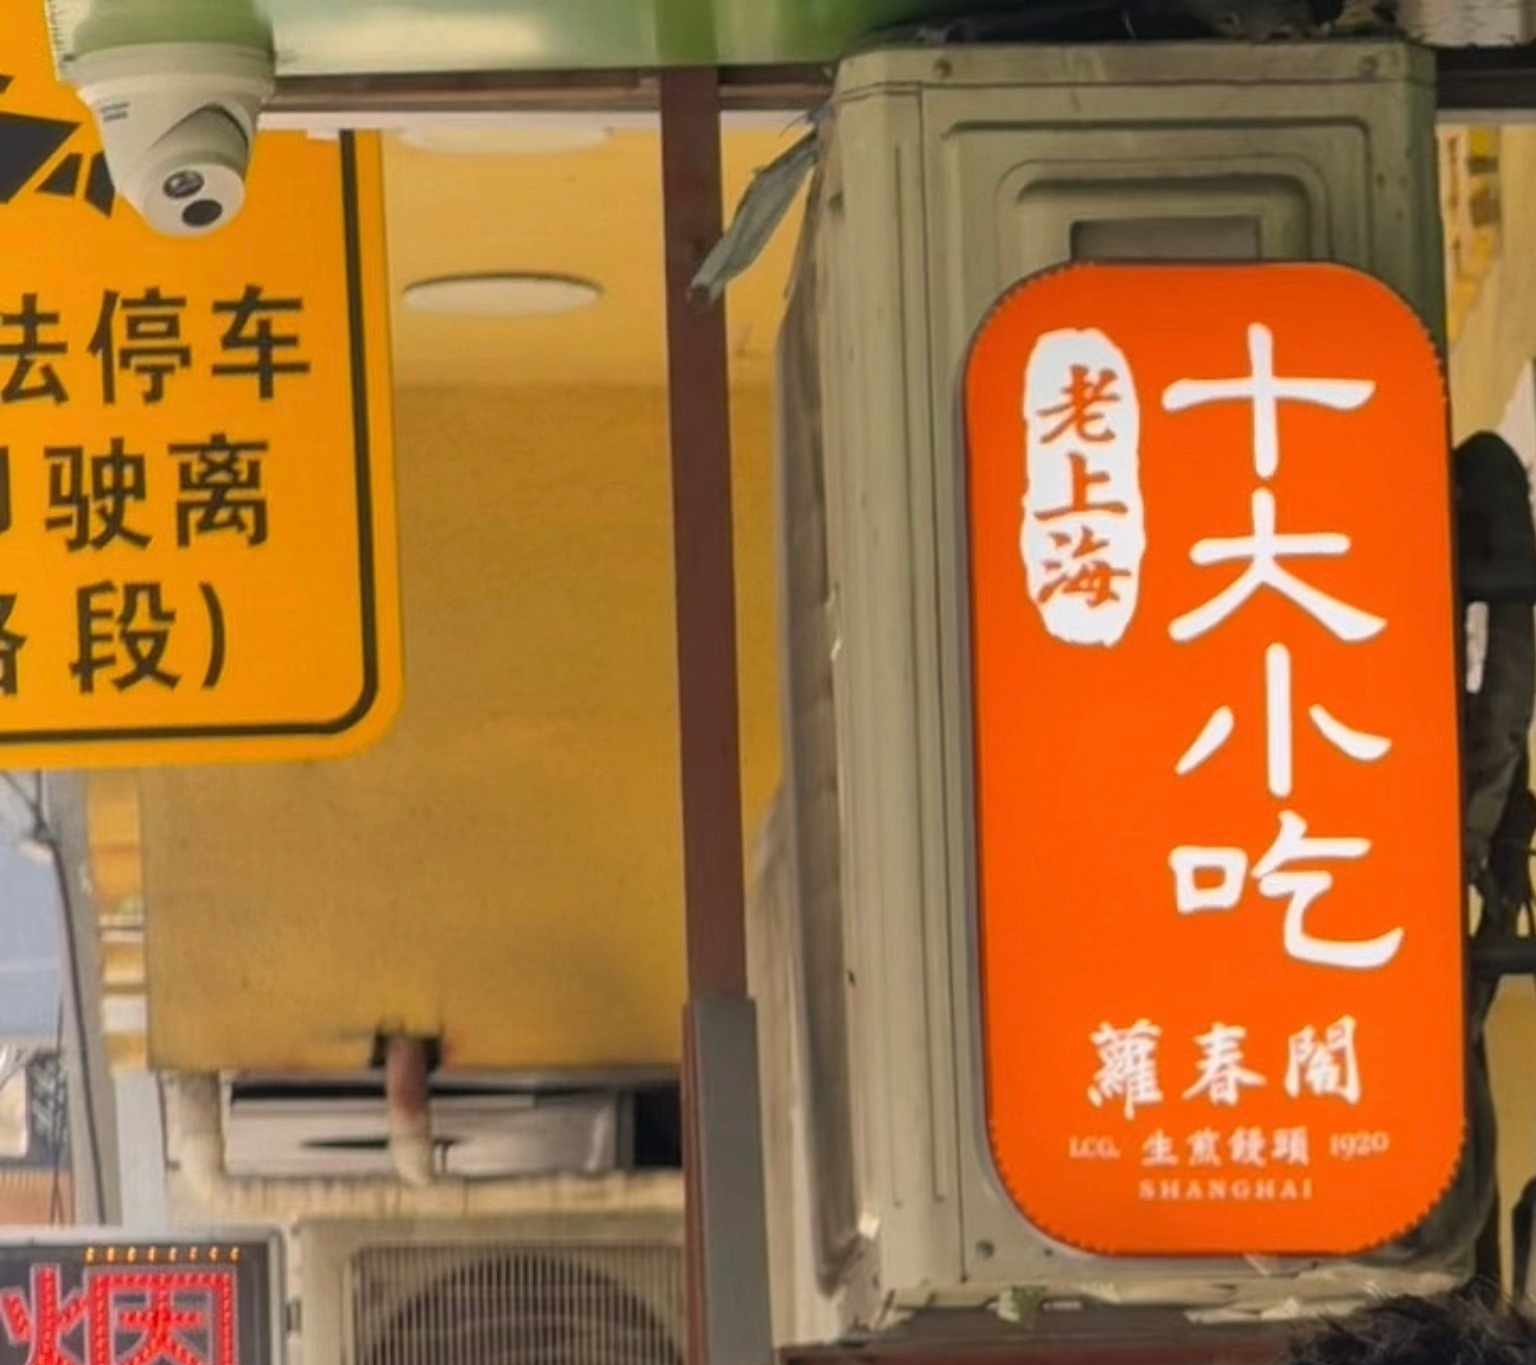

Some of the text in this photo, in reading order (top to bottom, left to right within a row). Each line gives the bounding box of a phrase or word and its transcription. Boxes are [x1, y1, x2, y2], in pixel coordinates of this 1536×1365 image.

[0, 433, 269, 552] 驶离
[1034, 364, 1132, 608] 老上海
[0, 580, 226, 695] 段）
[1162, 322, 1404, 968] 十大小吃
[1139, 1178, 1313, 1200] SHANGHAI
[1329, 1130, 1390, 1160] 1920
